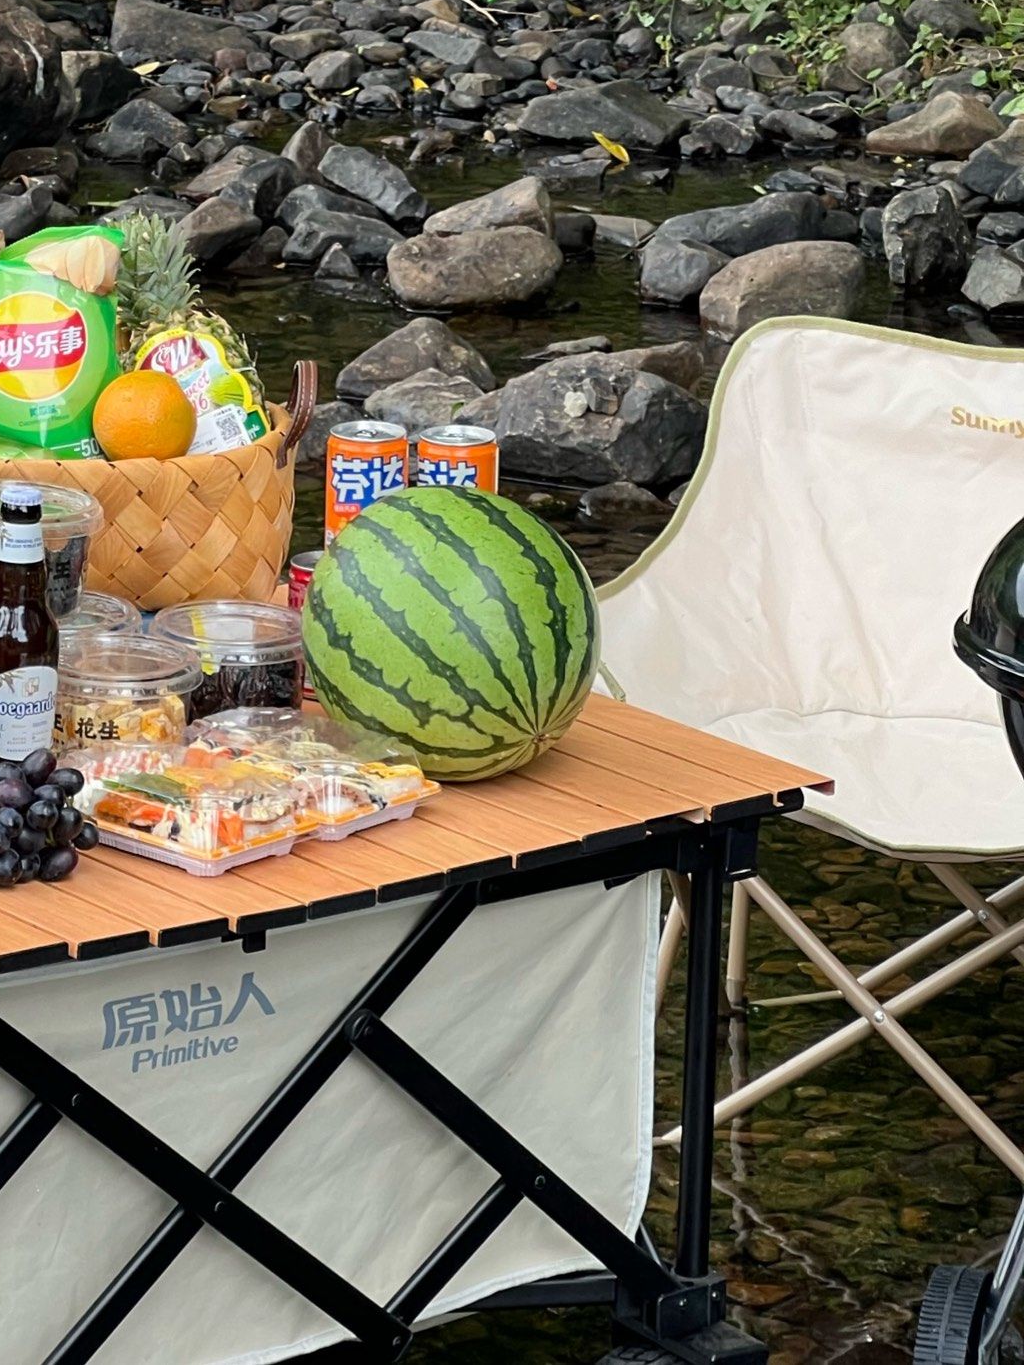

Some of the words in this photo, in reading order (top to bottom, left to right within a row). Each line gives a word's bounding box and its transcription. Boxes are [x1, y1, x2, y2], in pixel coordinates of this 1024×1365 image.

[34, 325, 84, 358] 乐事
[331, 453, 405, 504] 芬达
[75, 717, 121, 741] 花生
[102, 972, 276, 1051] 原始人
[131, 1035, 240, 1074] Primitive
